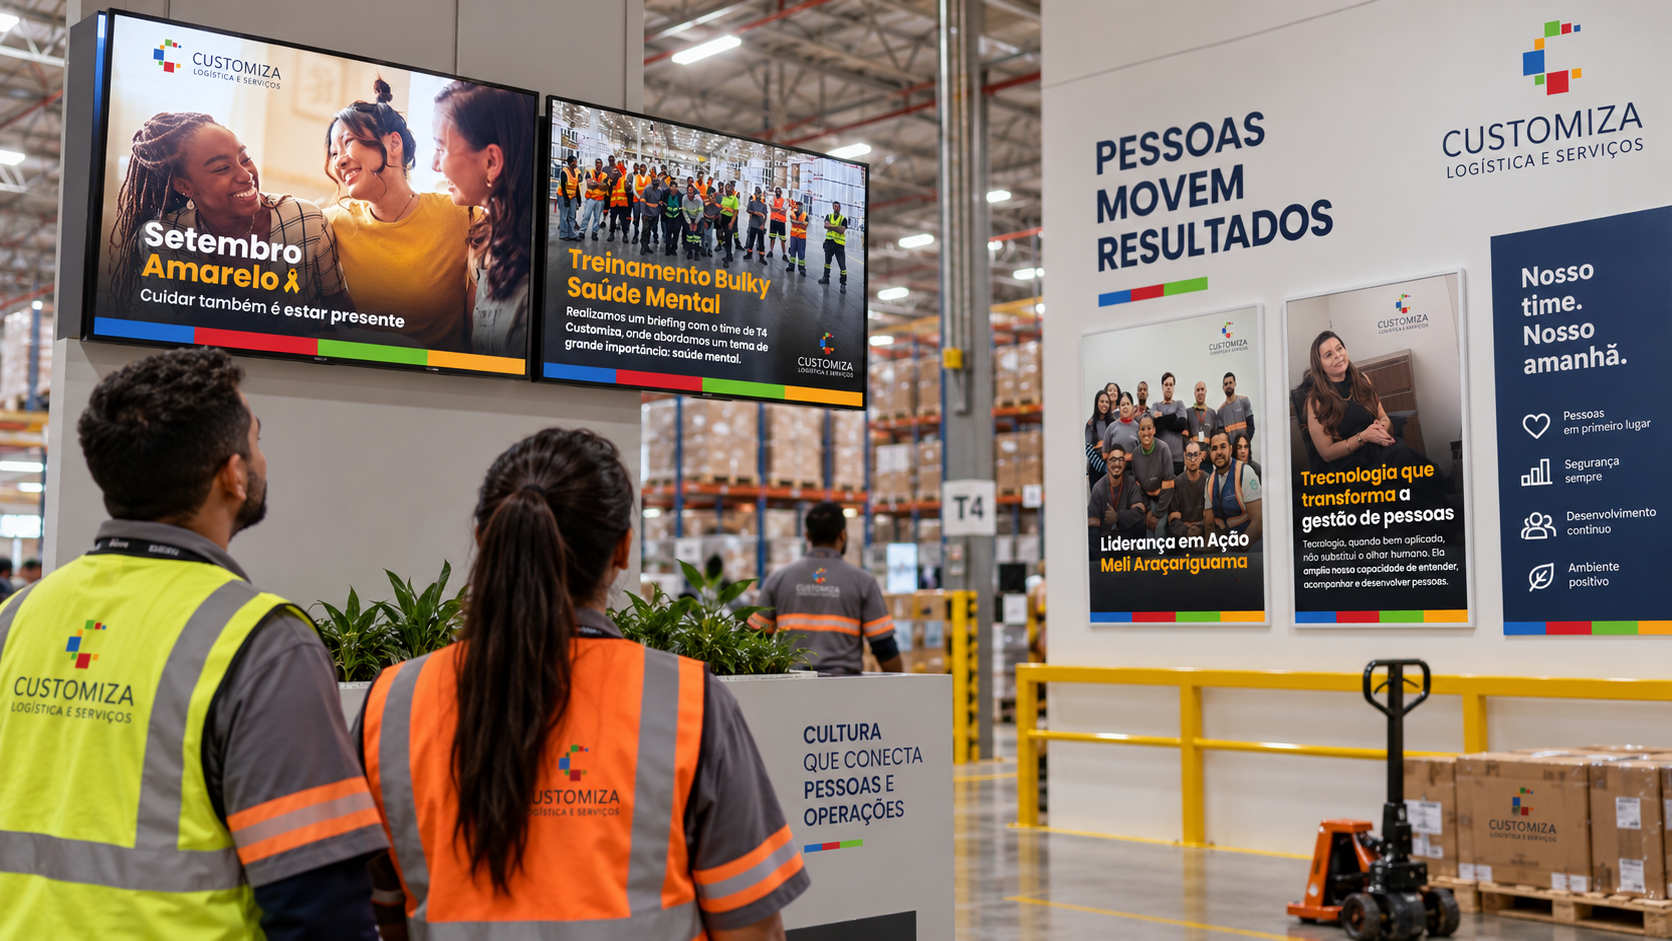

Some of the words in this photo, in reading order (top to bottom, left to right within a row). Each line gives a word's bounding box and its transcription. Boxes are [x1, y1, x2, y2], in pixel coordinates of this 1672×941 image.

[192, 52, 282, 80] CUSTOMIZA
[193, 68, 234, 81] LOGÍSTICA
[243, 77, 281, 90] SERVIÇOS
[1442, 102, 1644, 158] CUSTOMIZA
[1096, 111, 1266, 176] PESSOAS
[1447, 154, 1535, 178] LOGÍSTICA
[1541, 152, 1550, 165] E
[1556, 138, 1644, 163] SERVIÇOS
[1096, 164, 1244, 224] MOVEM
[144, 222, 302, 264] Setembro
[1098, 198, 1334, 272] RESULTADOS
[141, 253, 279, 291] Amarelo
[568, 248, 711, 286] Treinamento
[714, 269, 771, 300] Bulky
[1522, 264, 1594, 288] Nosso
[140, 288, 196, 306] Cuidar
[198, 294, 267, 314] também
[271, 301, 280, 315] é
[284, 303, 328, 320] estar
[331, 309, 406, 328] presente
[646, 286, 720, 314] Mental
[1521, 294, 1582, 316] time.
[566, 306, 626, 322] Realizamos
[628, 314, 644, 324] um
[647, 315, 686, 331] briefing
[687, 322, 710, 332] com
[720, 324, 740, 334] time
[742, 326, 755, 336] de
[756, 328, 768, 338] T4
[1378, 314, 1428, 328] CUSTOMIZA
[566, 322, 624, 339] Customiza,
[626, 330, 652, 340] onde
[654, 331, 710, 346] abordamos
[712, 339, 728, 348] um
[730, 340, 754, 350] tema
[756, 342, 768, 352] de
[1524, 322, 1595, 346] Nosso
[565, 339, 603, 350] grande
[672, 348, 703, 360] saúde
[704, 353, 742, 364] mental.
[798, 356, 854, 371] CUSTOMIZA
[1524, 343, 1628, 374] amanhã.
[1564, 410, 1604, 420] Pessoas
[1564, 426, 1579, 434] em
[1582, 421, 1624, 435] primeiro
[1626, 420, 1652, 431] lugar
[1301, 464, 1398, 486] Trecnologia
[1401, 464, 1434, 483] que
[1564, 458, 1620, 470] Segurança
[1565, 473, 1602, 484] sempre
[952, 496, 984, 520] T4
[1302, 489, 1396, 507] transforma
[1399, 488, 1410, 500] a
[1302, 510, 1357, 533] gestão
[1360, 510, 1380, 525] de
[1384, 508, 1454, 528] pessoas
[1566, 508, 1656, 521] Desenvolvimento
[1100, 535, 1176, 554] Liderança
[1178, 536, 1204, 548] em
[1208, 530, 1250, 552] Ação
[1383, 536, 1402, 544] bem
[1100, 555, 1131, 572] Meli
[1134, 554, 1248, 576] Araçariguama
[1406, 563, 1417, 572] de
[1418, 562, 1458, 572] entender,
[1568, 562, 1620, 572] Ambiente
[1361, 578, 1410, 587] desenvolver
[1569, 576, 1610, 589] positivo
[14, 676, 134, 706] CUSTOMIZA
[11, 701, 62, 716] LOGÍSTICA
[66, 706, 72, 717] E
[75, 708, 132, 724] SERVIÇOS
[804, 723, 882, 744] CULTURA
[804, 752, 840, 773] QUE
[844, 746, 923, 768] CONECTA
[532, 790, 620, 804] USTOMIZA
[804, 776, 882, 799] PESSOAS
[886, 774, 894, 792] E
[570, 808, 574, 816] E
[578, 808, 620, 818] SERVIÇOS
[804, 798, 904, 826] OPERAÇÕES
[1489, 819, 1556, 834] CUSTOMIZA
